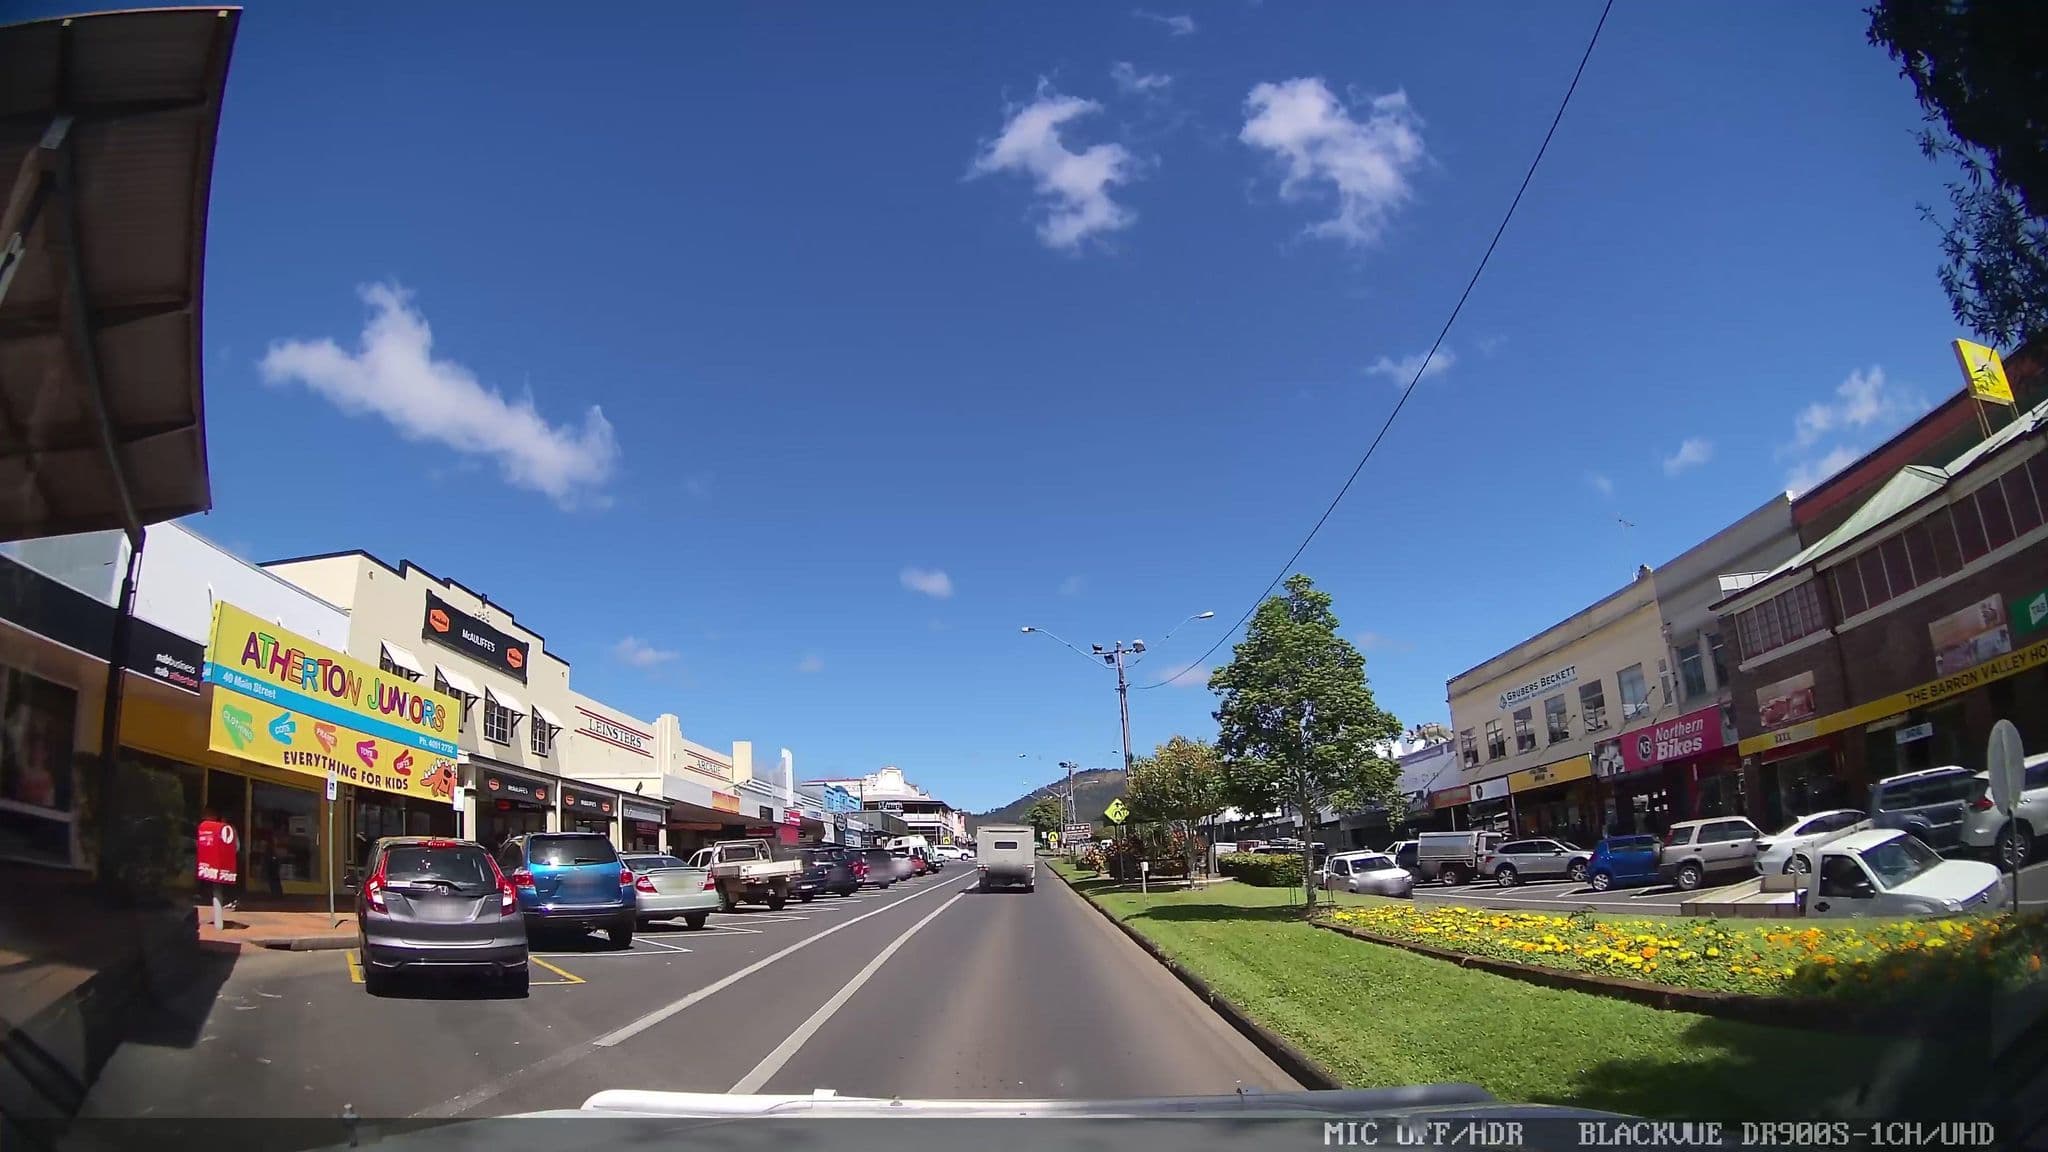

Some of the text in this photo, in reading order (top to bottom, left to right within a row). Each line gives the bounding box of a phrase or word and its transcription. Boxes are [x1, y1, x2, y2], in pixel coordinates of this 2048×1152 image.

[223, 671, 234, 684] 40
[234, 676, 252, 691] Main
[253, 682, 276, 699] Street
[241, 631, 446, 733] ATHERTON JUNIORS
[1506, 682, 1538, 700] GRUBERS
[1540, 666, 1576, 687] BECKETT
[1906, 645, 2048, 705] THE BARRON VALLEY HO
[589, 718, 642, 748] LEINSTERS
[1656, 719, 1704, 742] Northern
[1656, 736, 1703, 761] Bikes
[284, 751, 408, 790] EVERYTHING FOR KIDS
[696, 759, 721, 775] ARCADE
